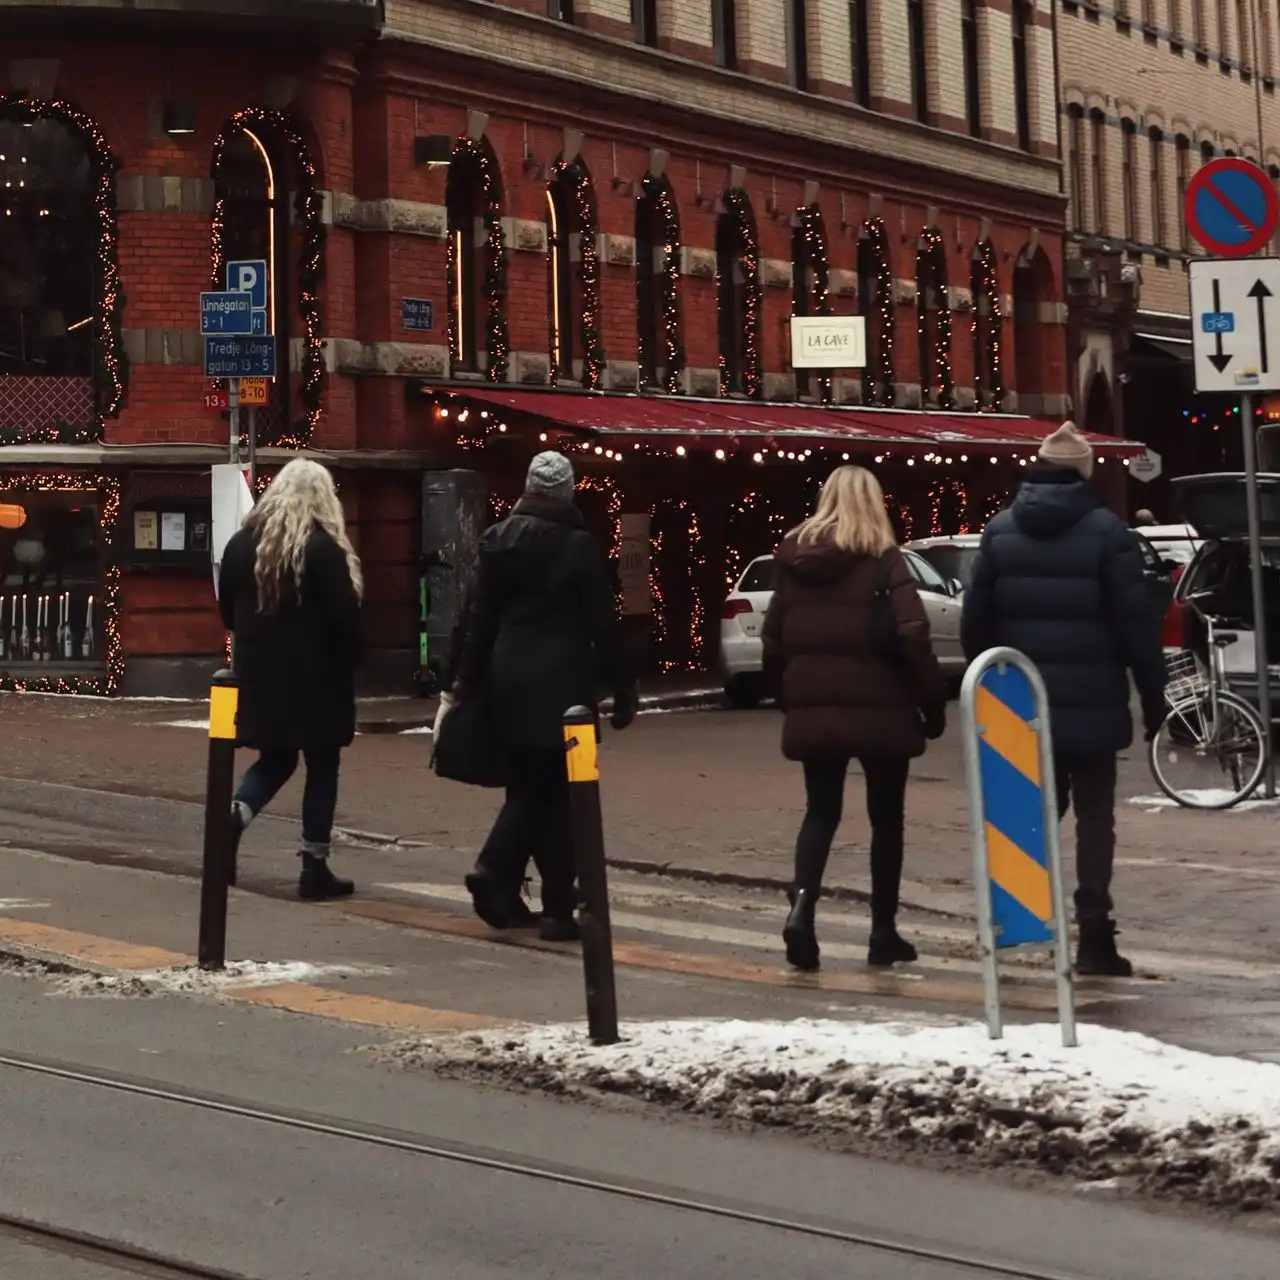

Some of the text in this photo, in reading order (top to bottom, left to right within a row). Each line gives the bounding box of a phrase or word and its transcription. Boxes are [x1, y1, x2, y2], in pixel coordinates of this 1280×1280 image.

[202, 297, 250, 314] Linnégatan
[808, 334, 850, 347] LA CAVE
[208, 341, 272, 356] Tredje Lång-
[208, 360, 238, 374] gatan
[204, 395, 219, 406] 13
